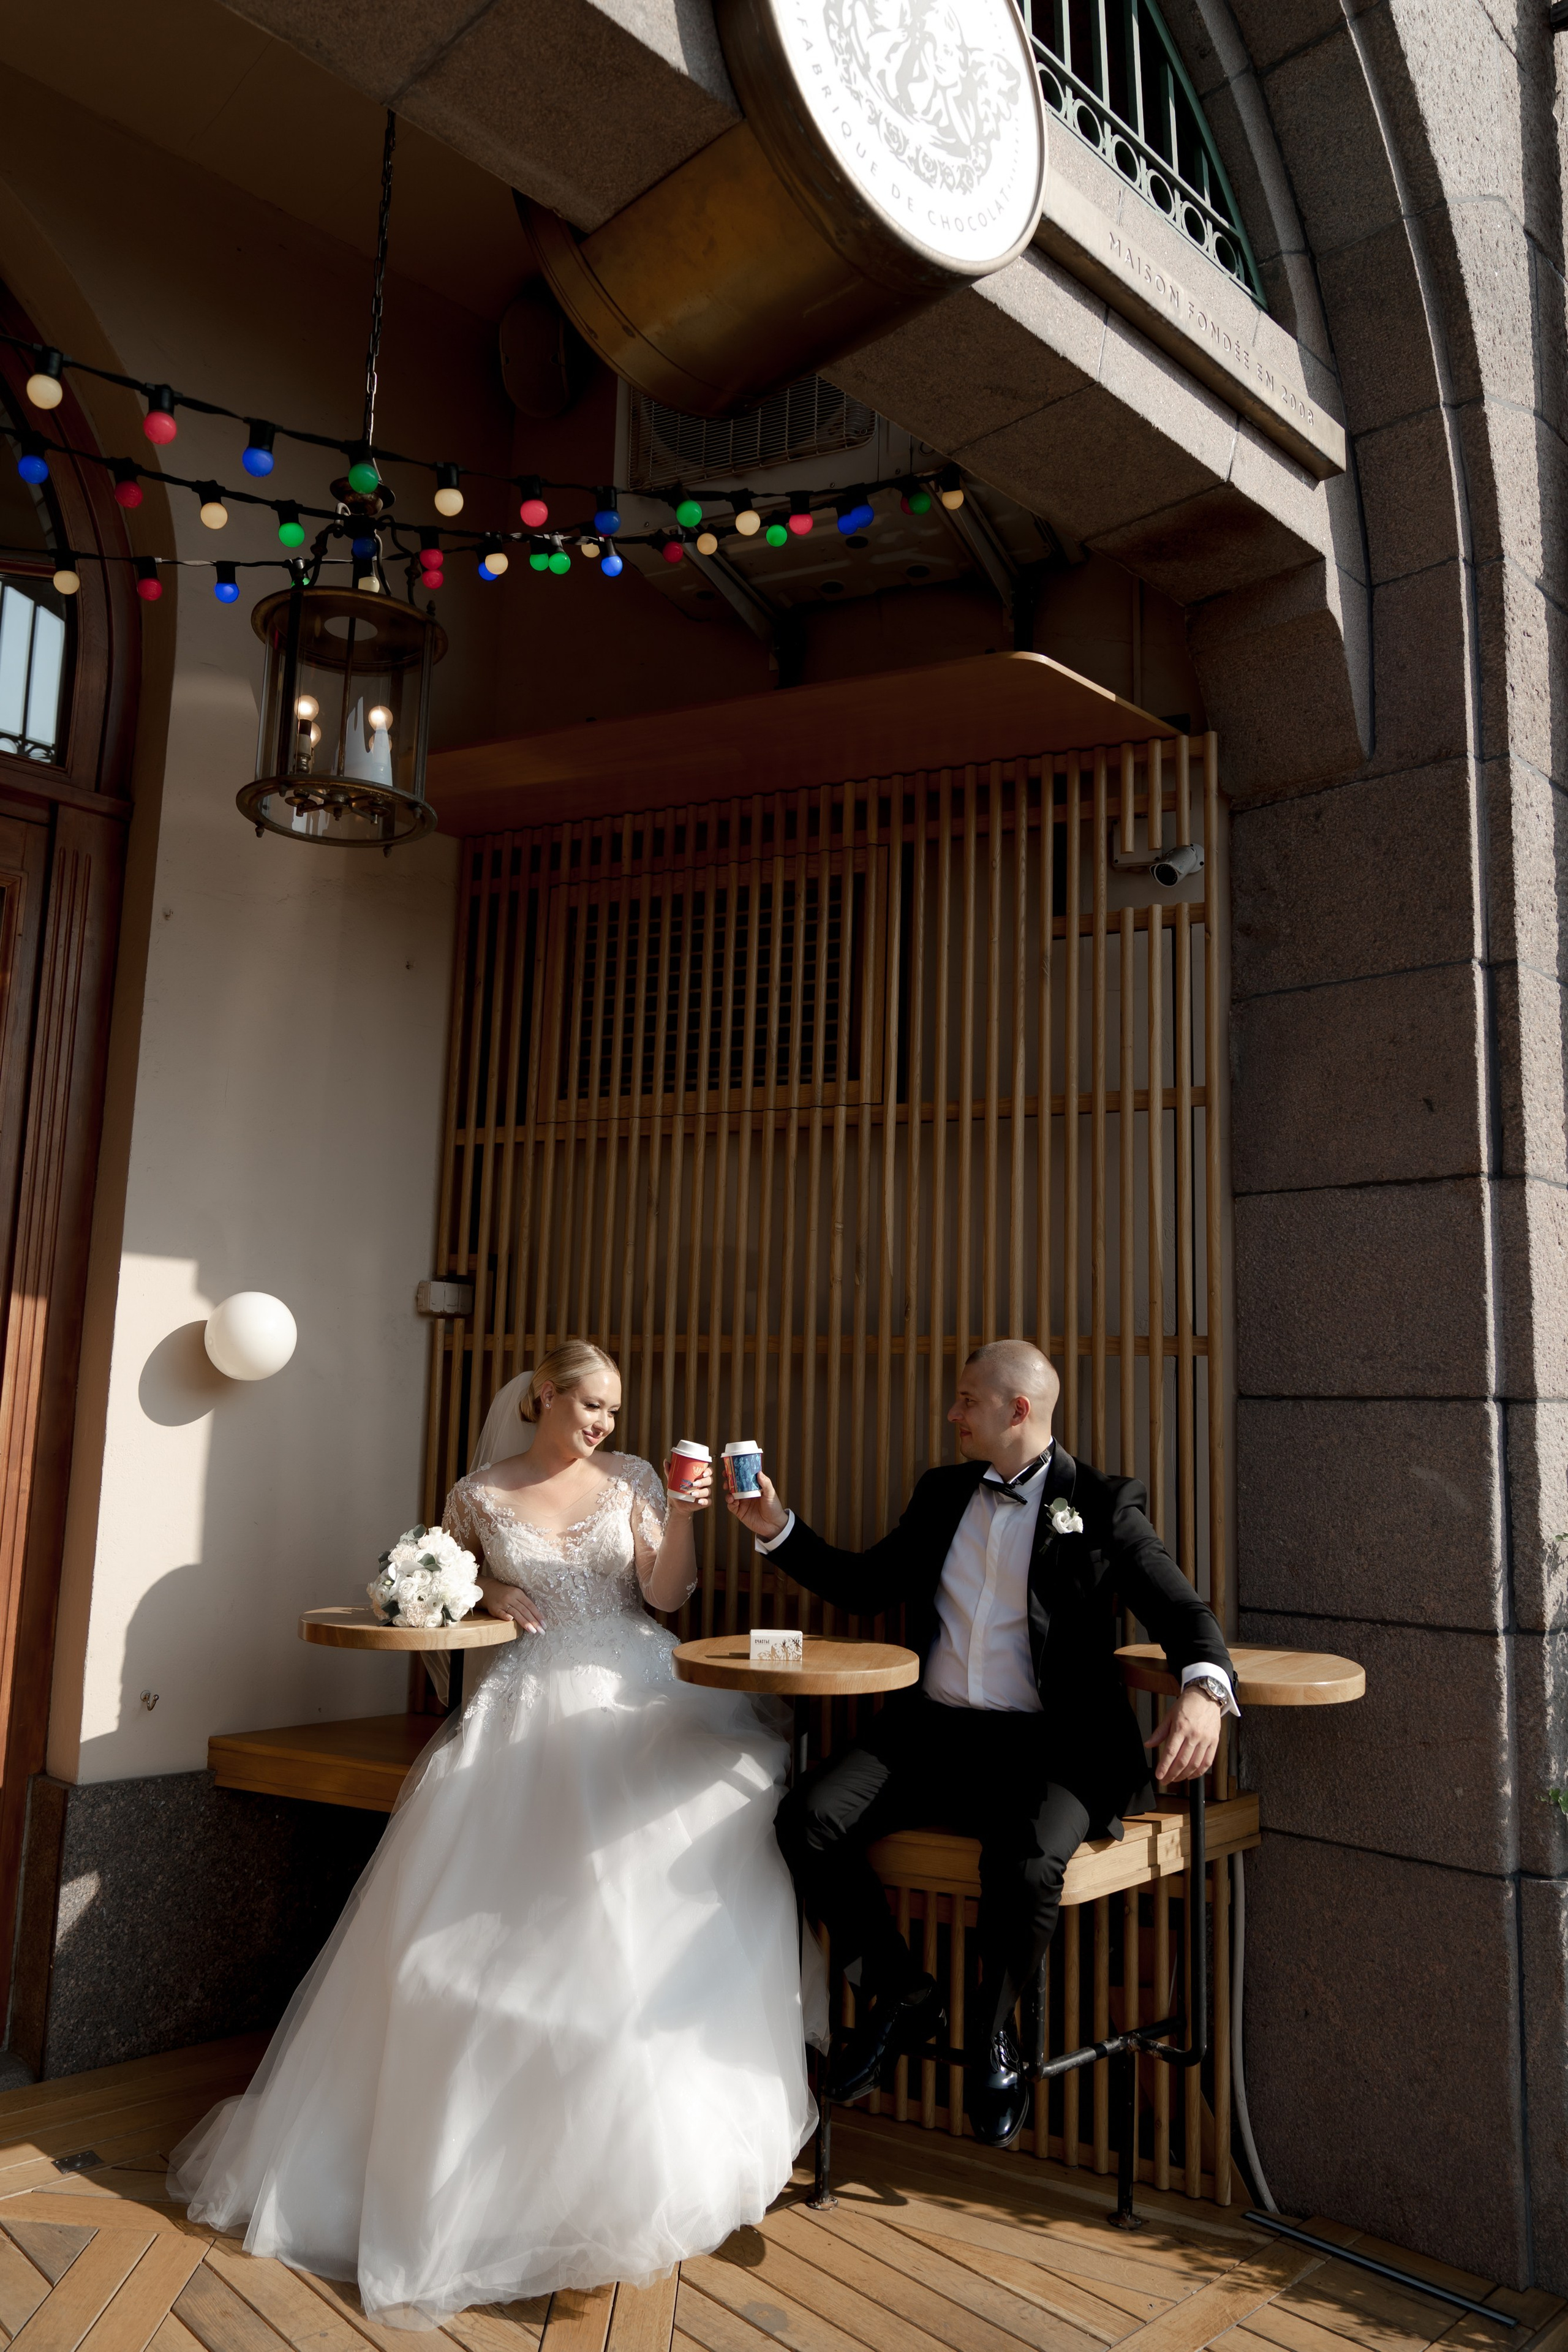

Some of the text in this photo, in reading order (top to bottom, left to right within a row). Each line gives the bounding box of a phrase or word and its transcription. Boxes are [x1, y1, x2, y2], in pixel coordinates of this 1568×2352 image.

[797, 17, 1009, 232] FABRIQUE DE CHOCOLAT
[1109, 232, 1314, 426] MAISON FONDÉE EN 2008
